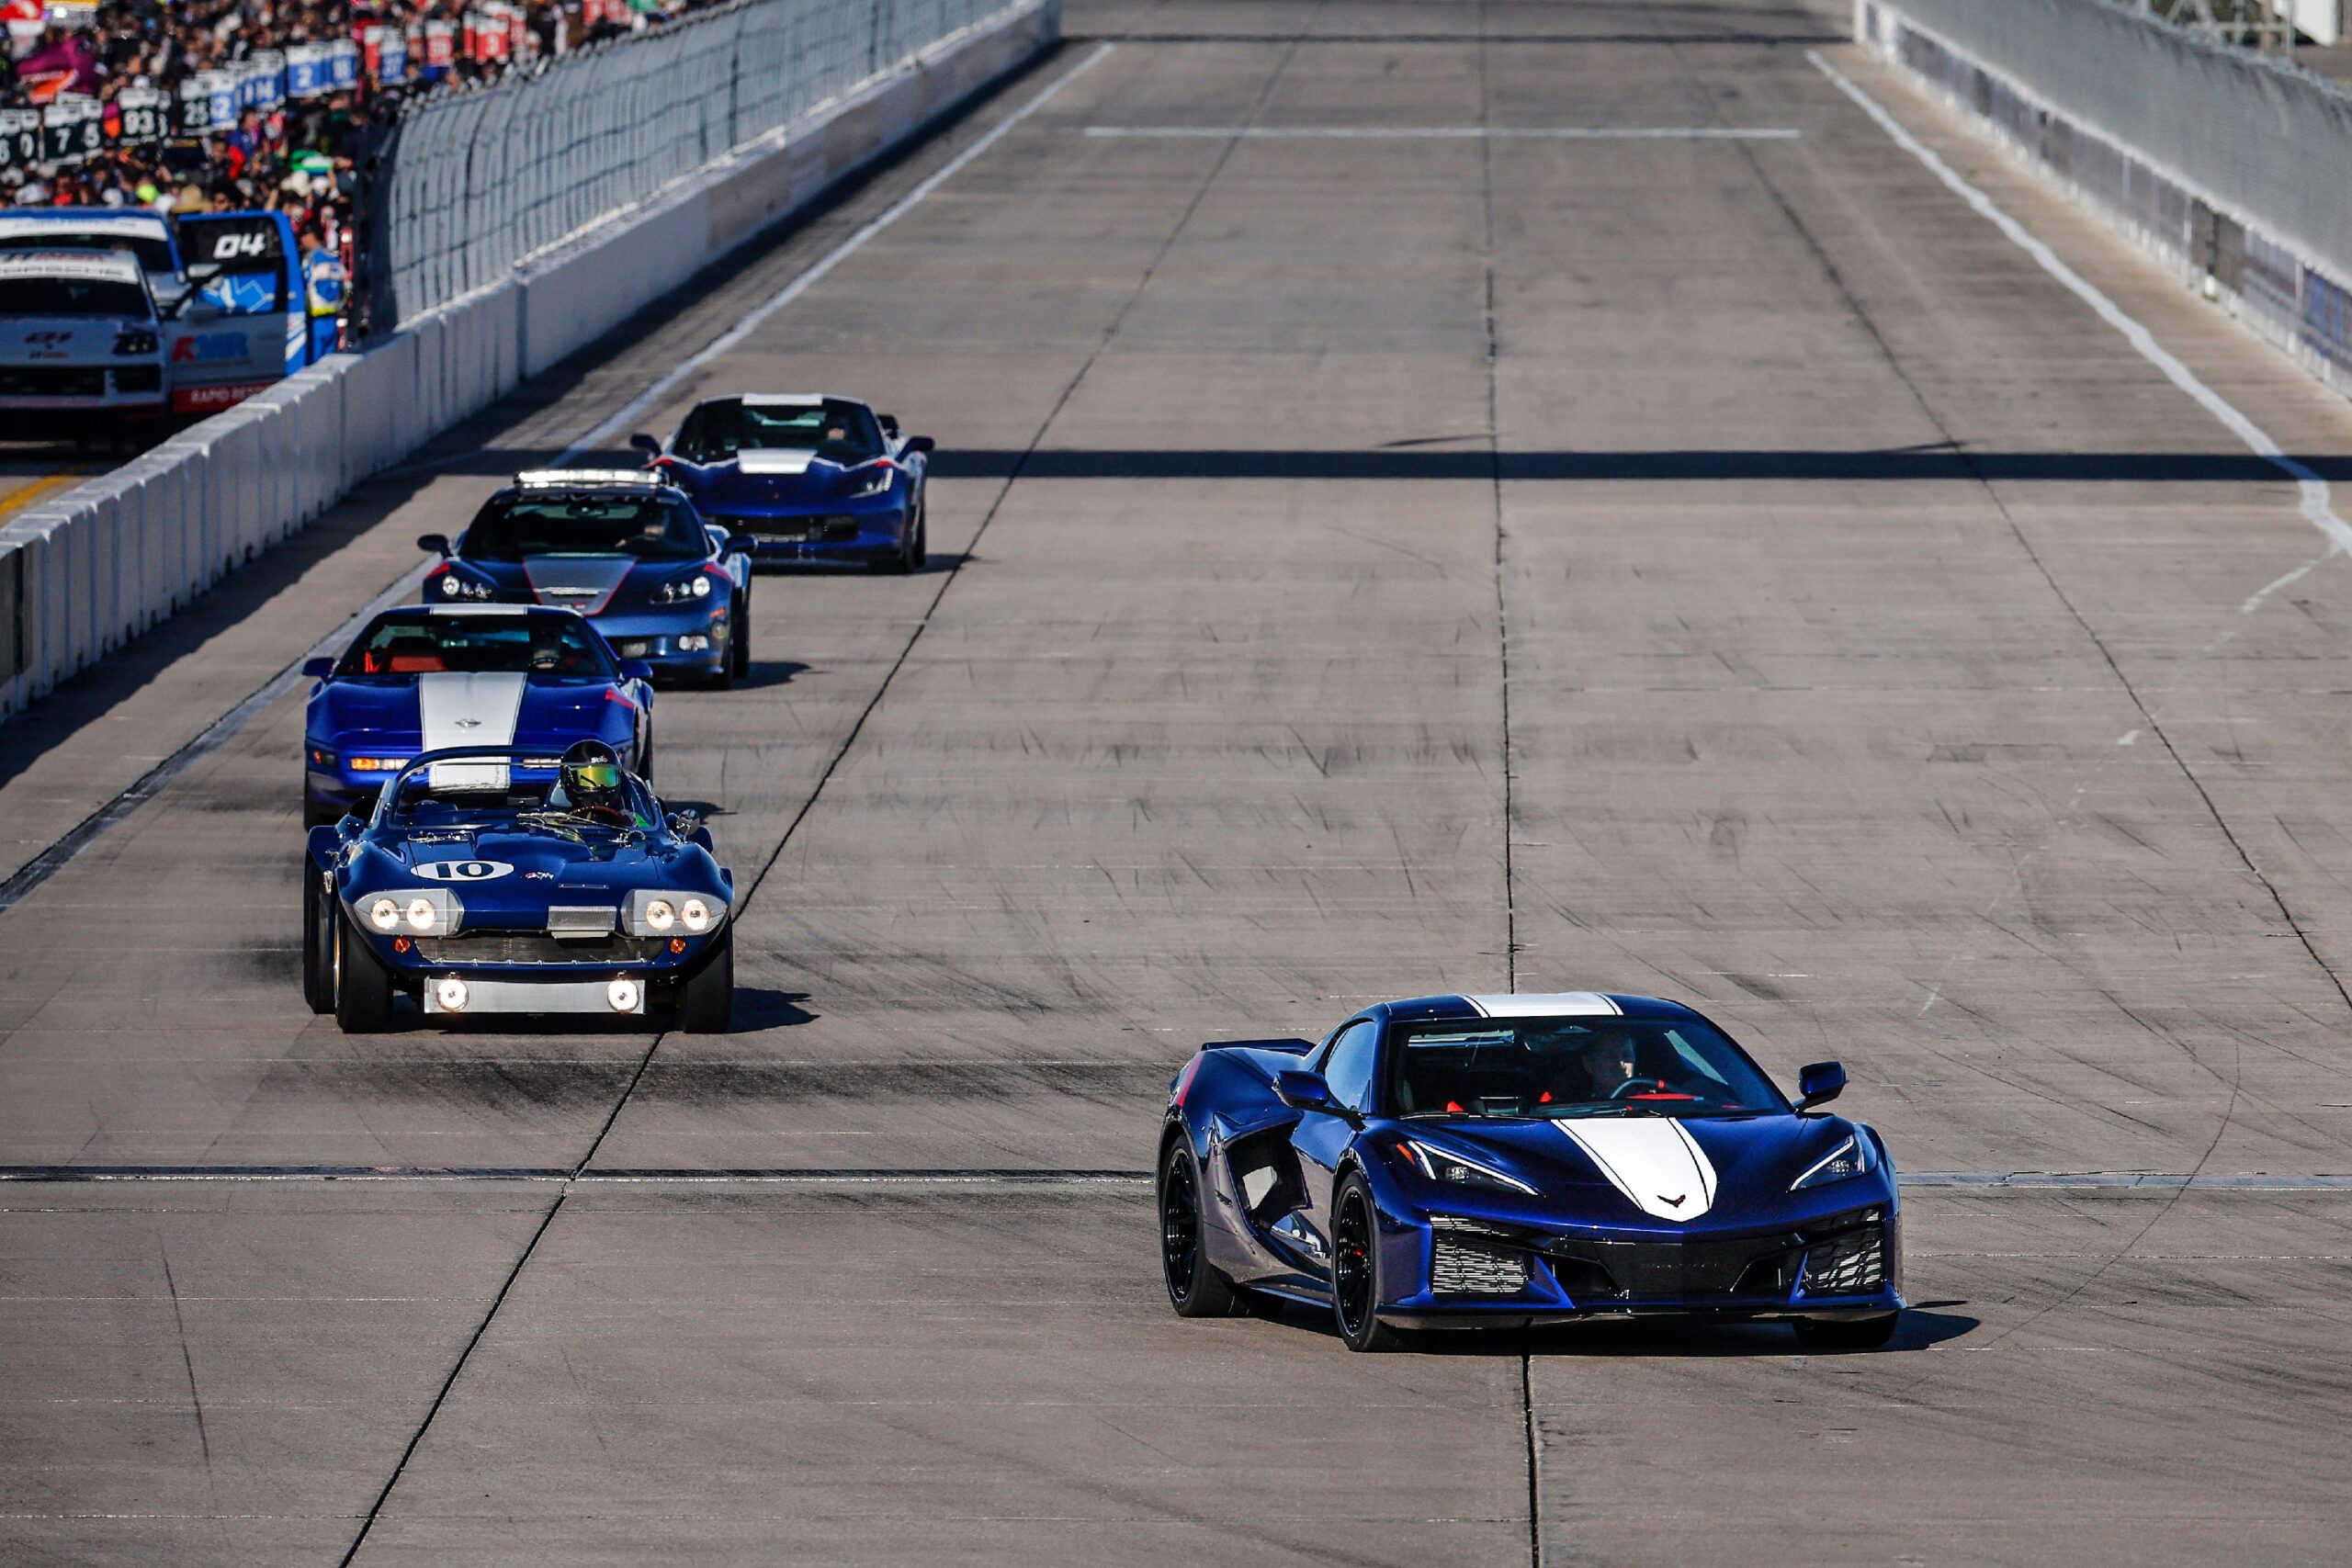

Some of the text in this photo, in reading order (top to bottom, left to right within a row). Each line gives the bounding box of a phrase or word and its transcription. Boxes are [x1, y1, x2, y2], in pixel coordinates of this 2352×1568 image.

[297, 66, 312, 88] 2
[210, 95, 231, 118] 2
[123, 109, 155, 135] 93
[55, 128, 71, 153] 7
[213, 233, 266, 259] 04
[435, 862, 495, 879] 10
